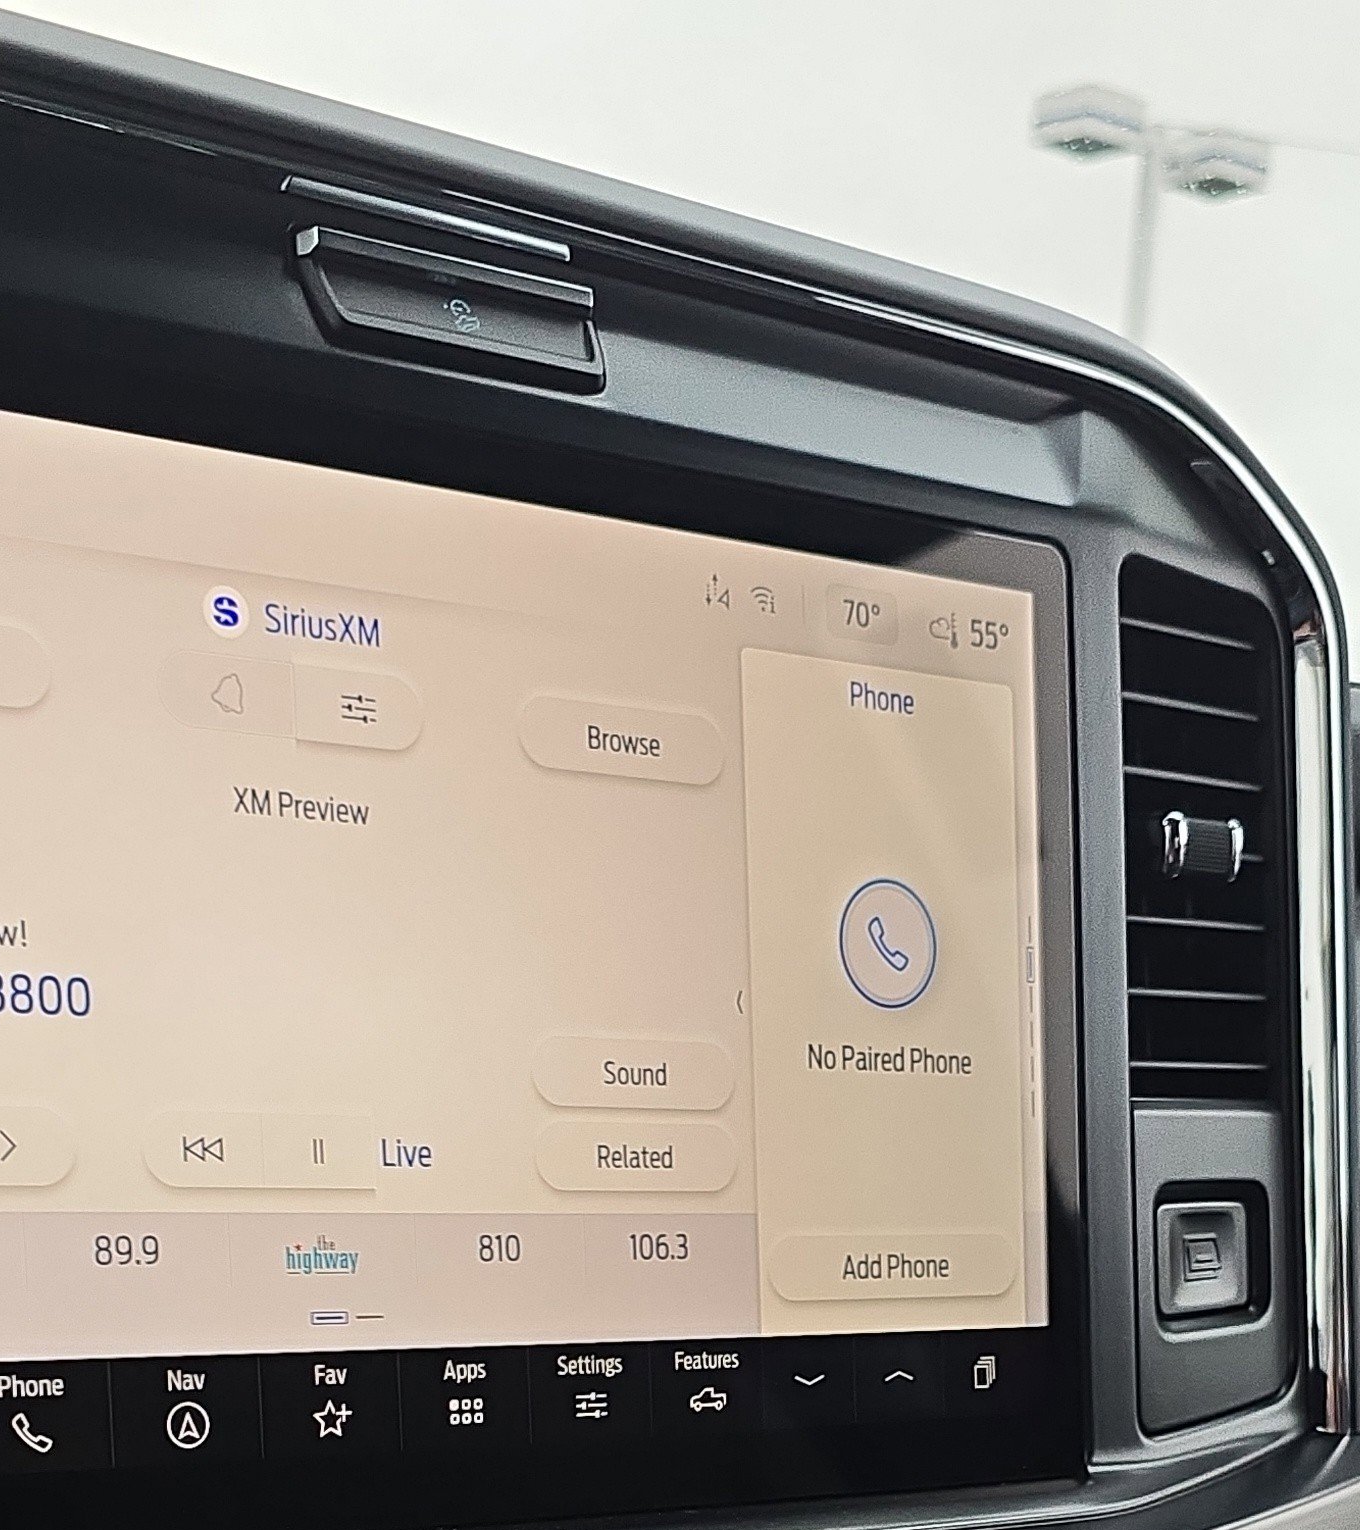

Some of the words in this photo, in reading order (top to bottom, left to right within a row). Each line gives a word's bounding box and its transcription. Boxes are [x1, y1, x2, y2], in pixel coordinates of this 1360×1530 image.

[264, 603, 380, 648] SiriusXM
[843, 598, 881, 628] 70°
[970, 618, 1009, 650] 55°
[850, 680, 915, 715] Phone
[587, 724, 661, 757] Browse
[233, 786, 272, 816] XM
[278, 791, 370, 825] Preview
[808, 1043, 837, 1070] No
[841, 1044, 905, 1073] Paired
[910, 1047, 972, 1075] Phone
[603, 1060, 667, 1087] Sound
[381, 1138, 432, 1168] Live
[597, 1144, 673, 1169] Related
[95, 1235, 159, 1266] 89.9
[318, 1234, 336, 1251] the
[479, 1234, 521, 1263] 810
[629, 1233, 689, 1261] 106.3
[285, 1246, 358, 1274] highway
[842, 1253, 882, 1280] Add
[887, 1253, 949, 1279] Phone
[314, 1364, 348, 1386] Fav
[443, 1359, 487, 1384] Apps
[557, 1355, 623, 1378] Settings
[674, 1351, 740, 1371] Features
[167, 1369, 206, 1392] Nav
